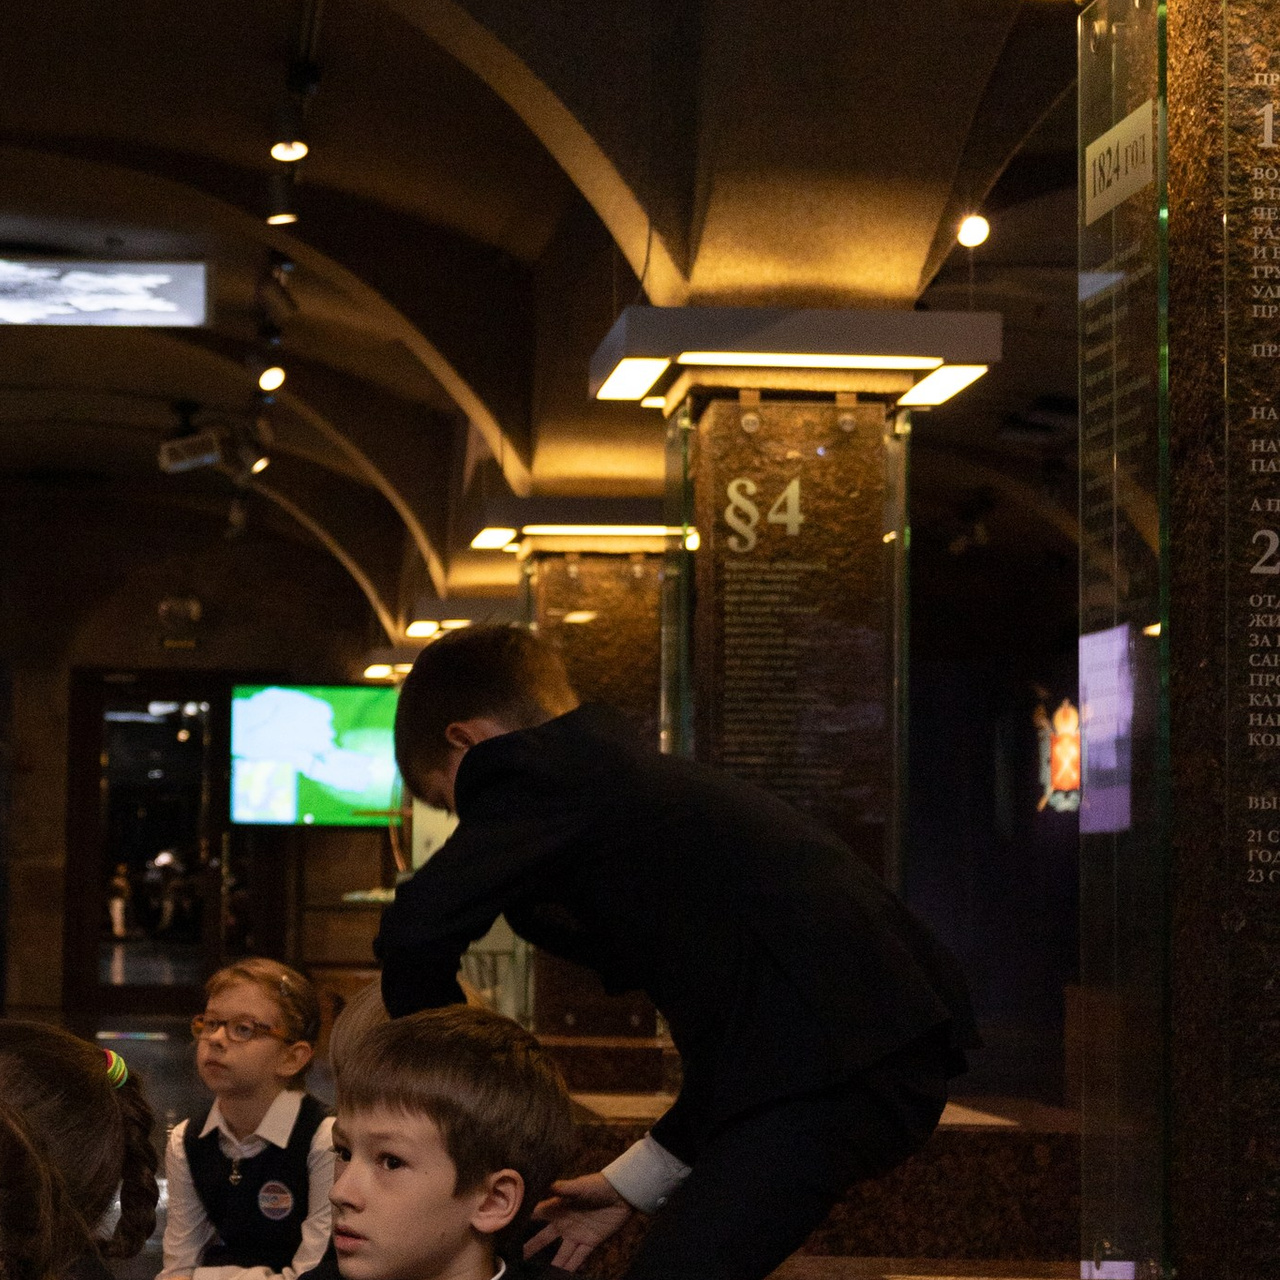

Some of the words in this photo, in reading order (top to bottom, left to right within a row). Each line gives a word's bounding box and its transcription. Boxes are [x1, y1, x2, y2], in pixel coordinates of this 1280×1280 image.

[1092, 139, 1120, 199] 1824
[1253, 227, 1280, 240] РА
[1250, 439, 1280, 452] НА
[1247, 829, 1262, 843] 21
